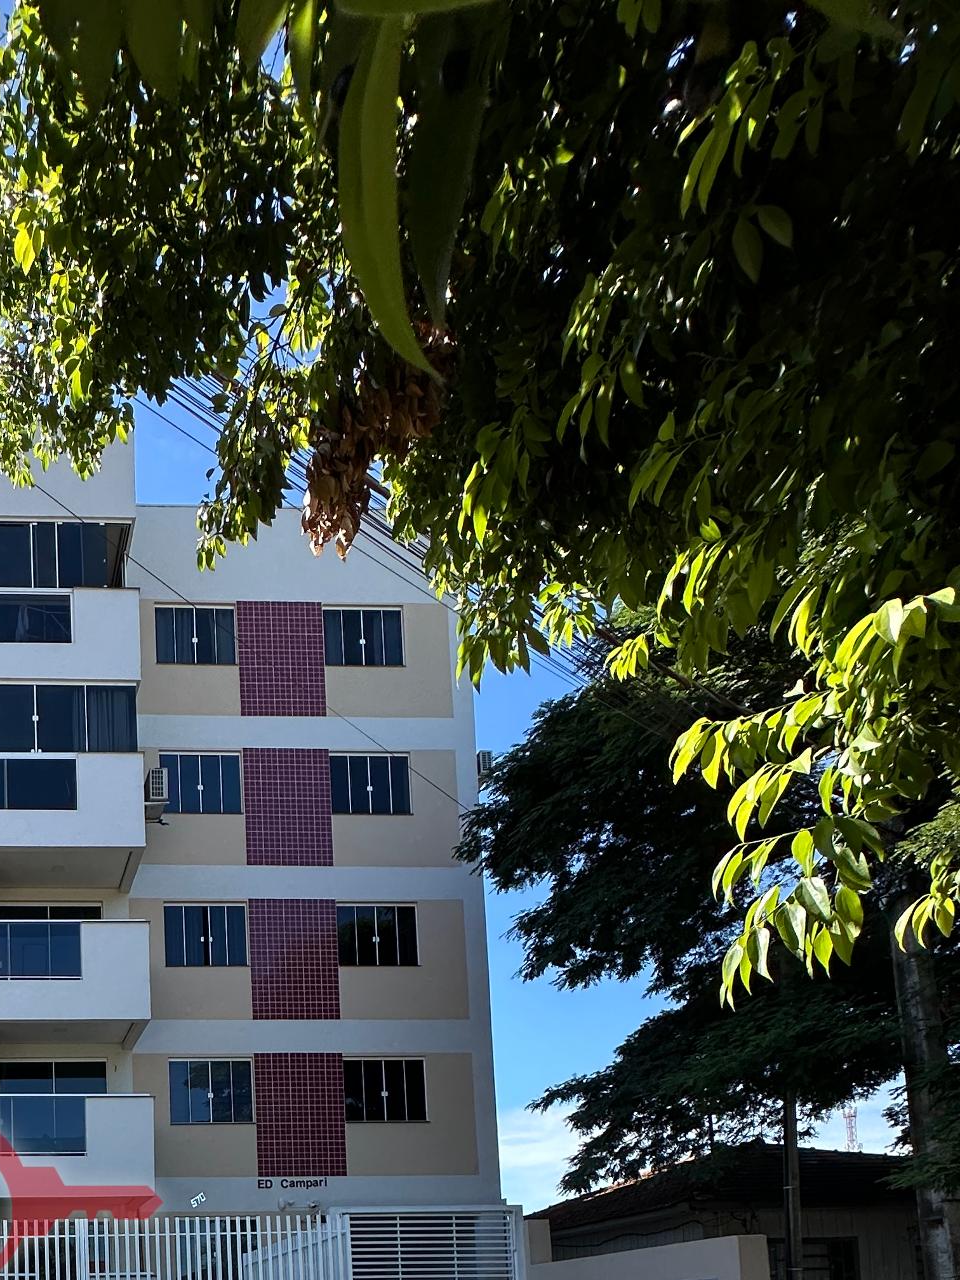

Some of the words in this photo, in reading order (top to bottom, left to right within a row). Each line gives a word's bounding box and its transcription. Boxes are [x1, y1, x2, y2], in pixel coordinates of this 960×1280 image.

[257, 1179, 273, 1189] ED
[280, 1177, 327, 1189] Campari
[190, 1192, 206, 1208] 570
